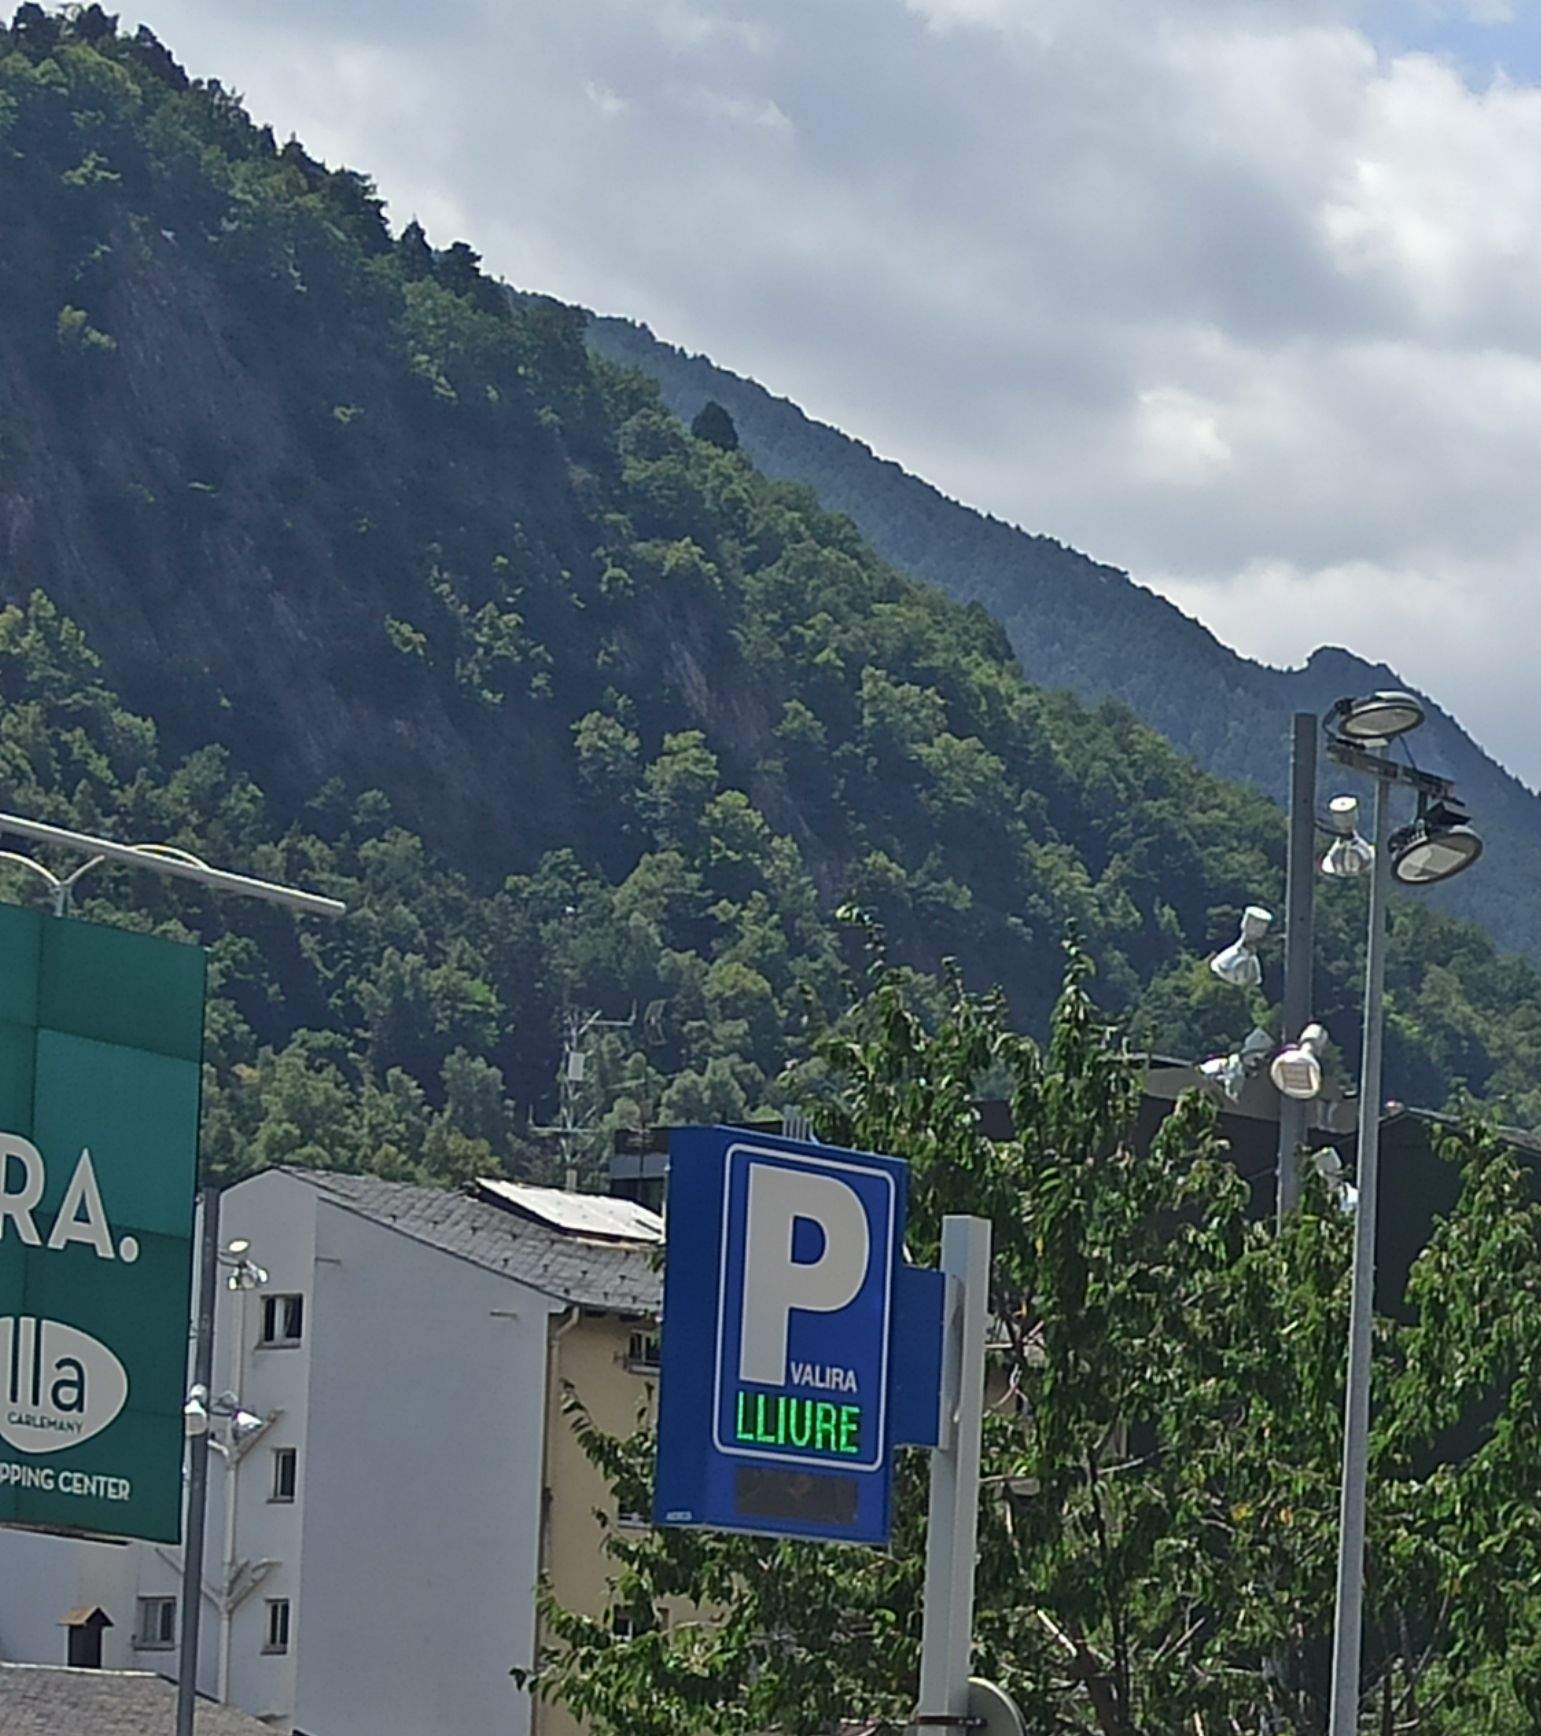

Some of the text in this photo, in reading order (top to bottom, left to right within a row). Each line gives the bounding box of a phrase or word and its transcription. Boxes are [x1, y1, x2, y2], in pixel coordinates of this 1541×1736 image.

[738, 1162, 870, 1386] P
[790, 1361, 858, 1393] VALIRA
[7, 1411, 84, 1435] CARLEMANY
[736, 1390, 861, 1454] LLIURE
[58, 1471, 130, 1500] CENTER
